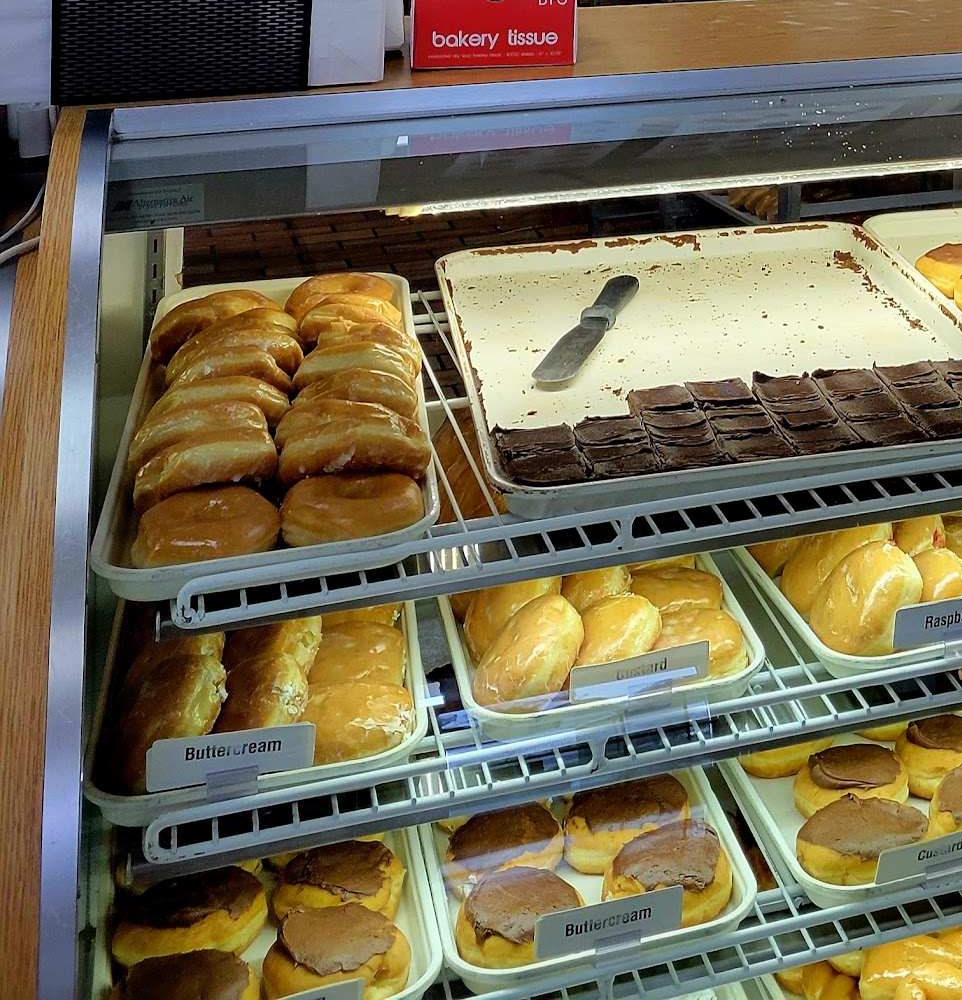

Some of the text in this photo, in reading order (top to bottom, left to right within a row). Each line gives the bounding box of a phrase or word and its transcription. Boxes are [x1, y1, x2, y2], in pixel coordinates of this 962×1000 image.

[432, 28, 559, 50] bakery tissue
[184, 739, 282, 762] Buttercream
[565, 906, 652, 938] Buttercream
